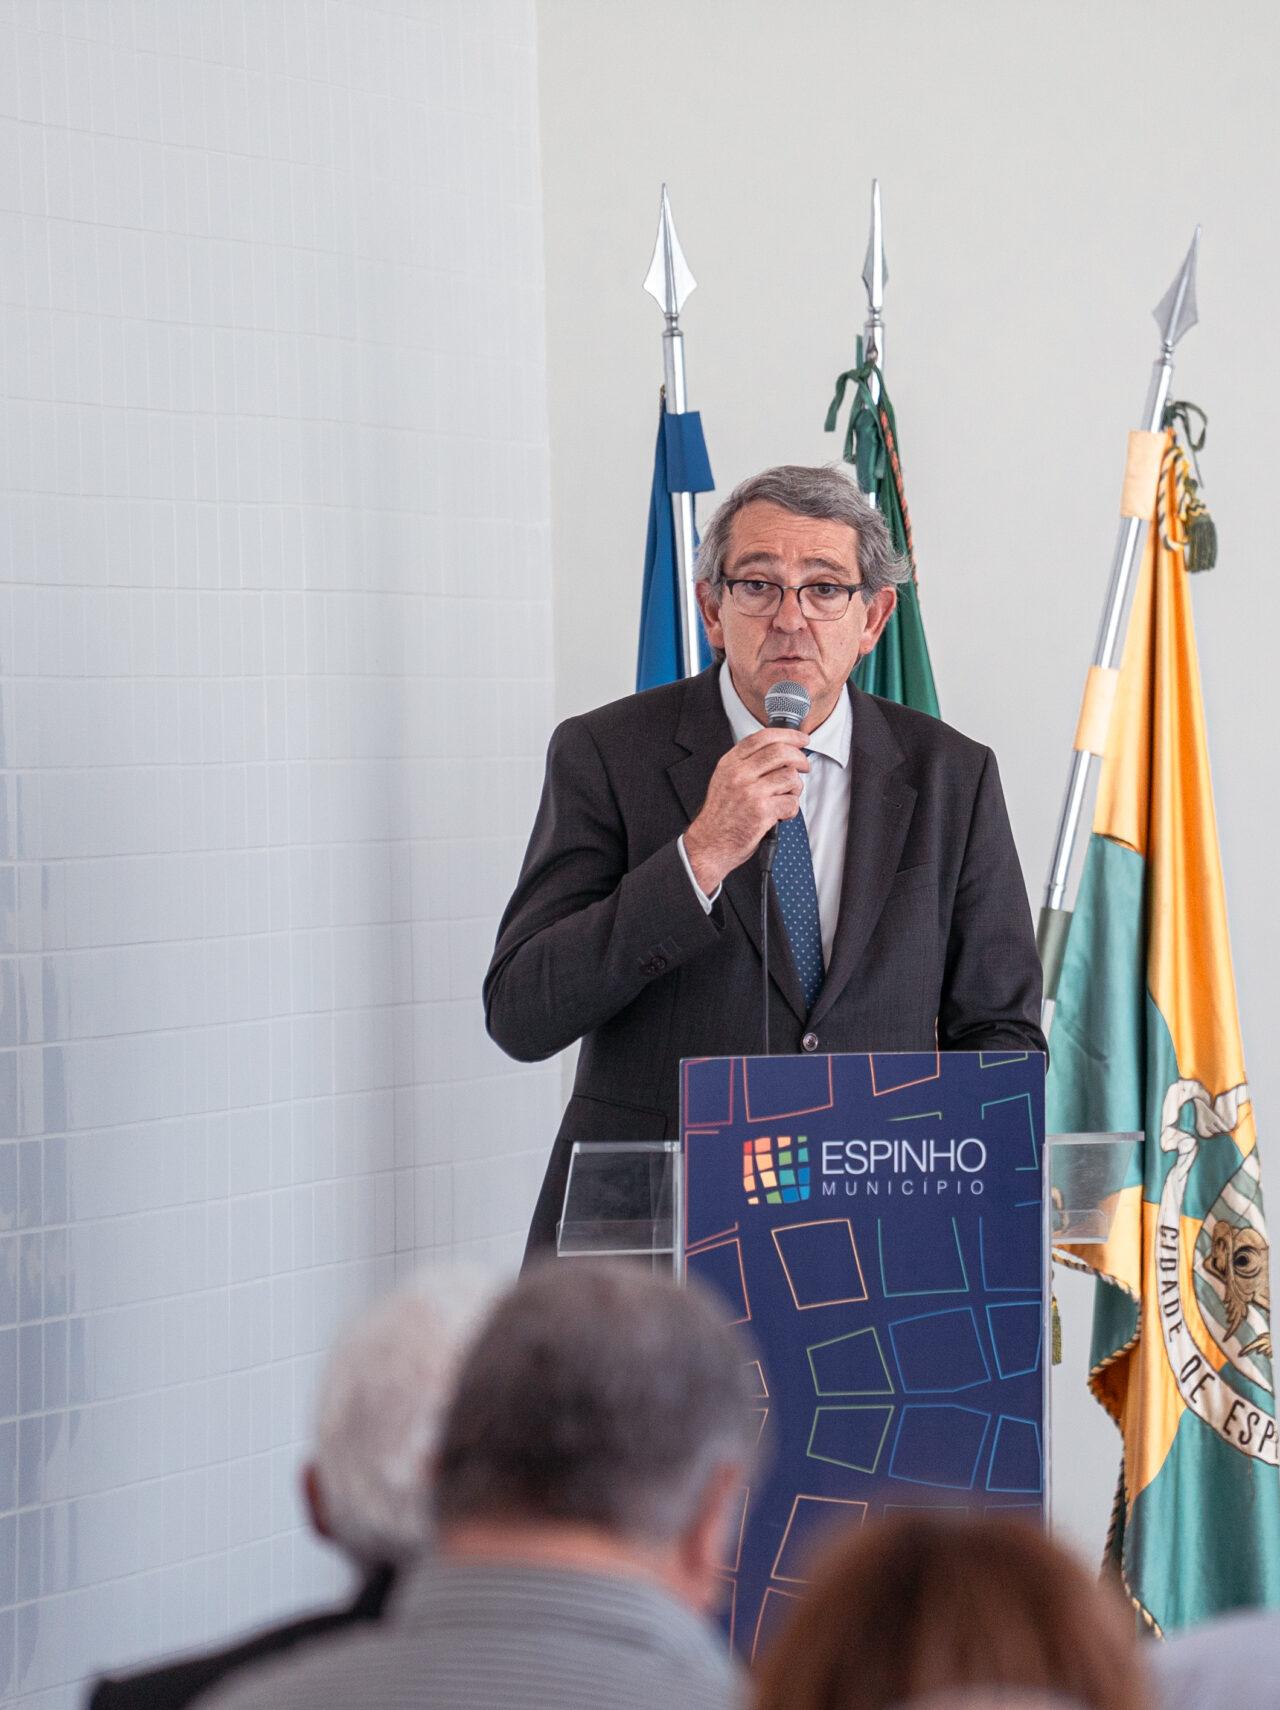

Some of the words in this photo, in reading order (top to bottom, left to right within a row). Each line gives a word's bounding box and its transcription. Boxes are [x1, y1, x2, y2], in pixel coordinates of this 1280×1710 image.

[821, 1138, 987, 1174] ESPINHO
[822, 1179, 985, 1196] MUNICÍPIO
[1159, 1224, 1183, 1343] CIDADE
[1180, 1353, 1216, 1405] DE
